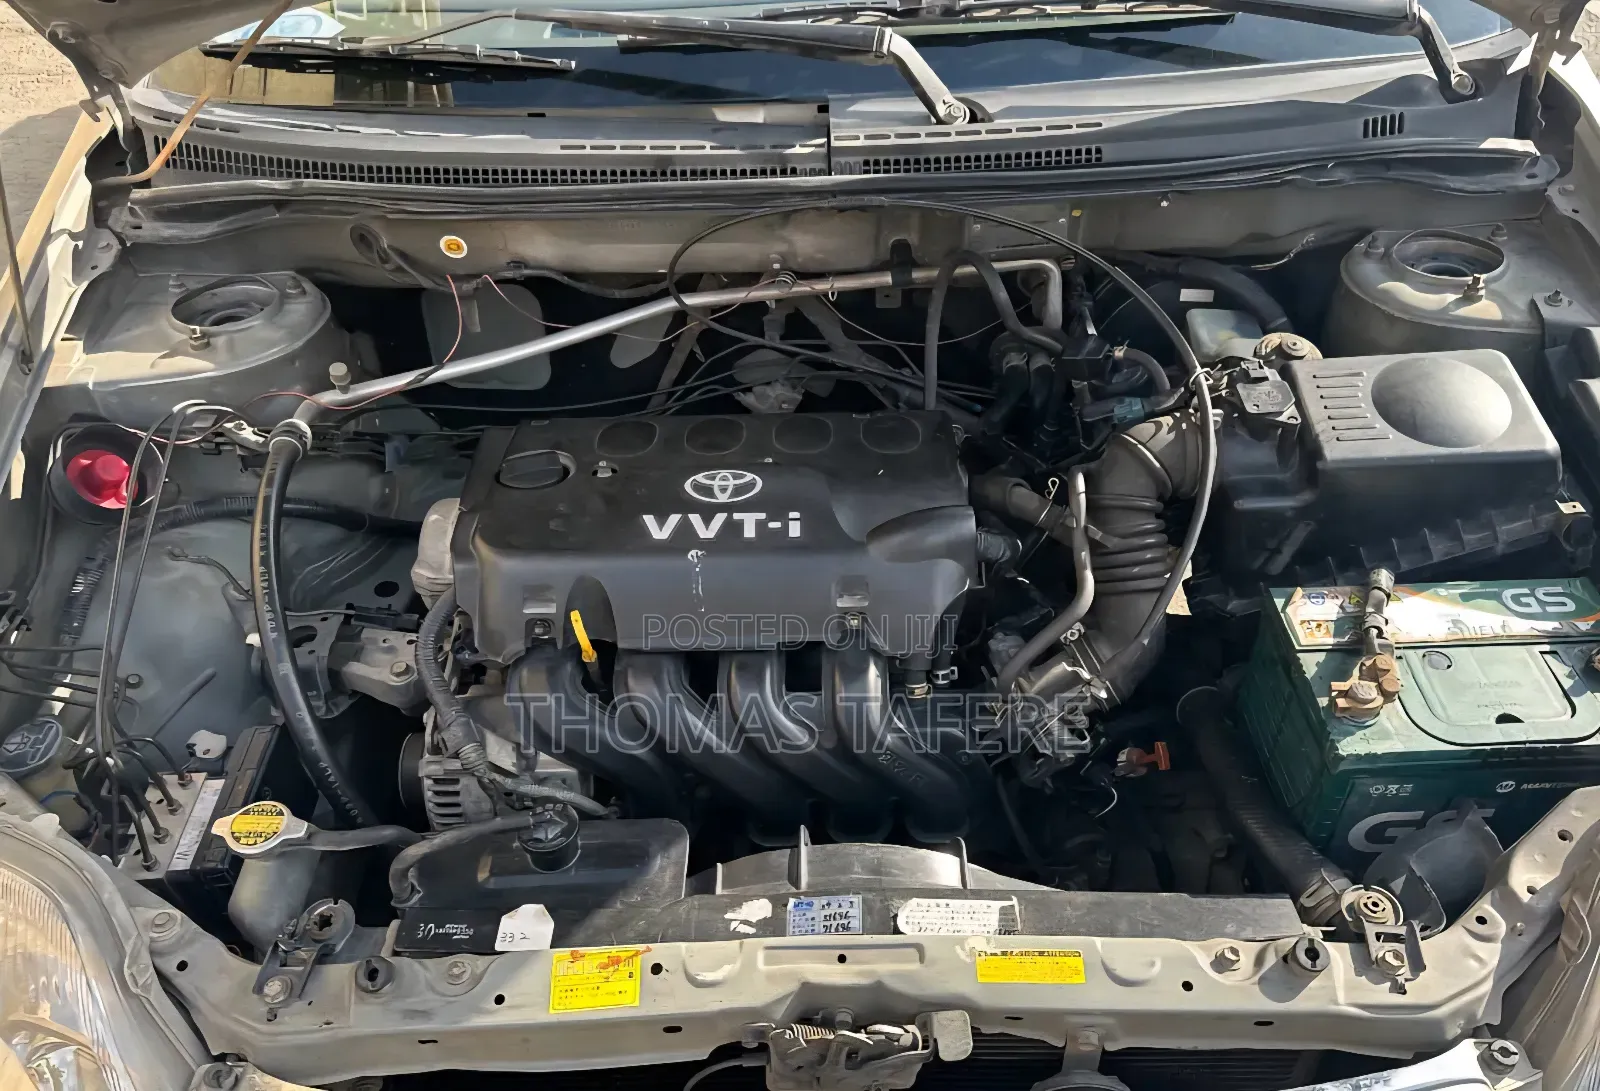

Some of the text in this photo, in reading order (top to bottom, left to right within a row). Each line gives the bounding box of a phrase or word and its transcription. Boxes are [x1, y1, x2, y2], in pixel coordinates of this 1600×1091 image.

[642, 512, 801, 540] VVT-i
[1501, 587, 1576, 613] GS
[1347, 810, 1495, 853] G
